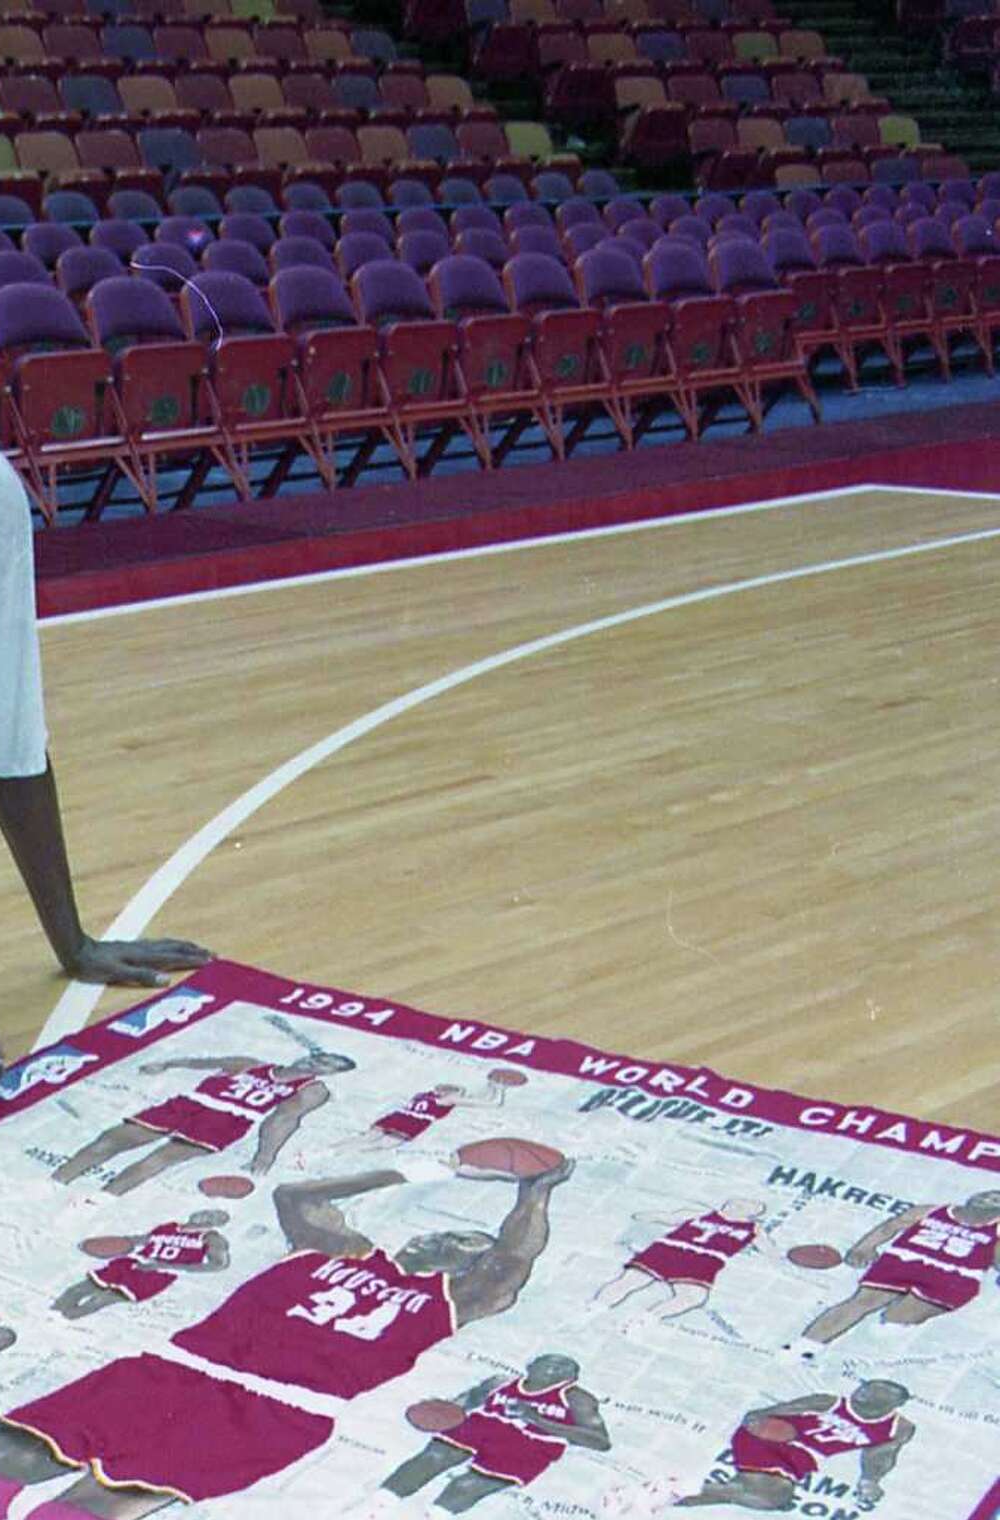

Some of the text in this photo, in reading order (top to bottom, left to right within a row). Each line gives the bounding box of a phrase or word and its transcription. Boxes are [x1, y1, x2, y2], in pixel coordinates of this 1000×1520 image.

[281, 988, 395, 1026] 1994
[439, 1023, 537, 1057] NBA
[578, 1055, 755, 1109] WORLD
[767, 1165, 916, 1217] HAKREE
